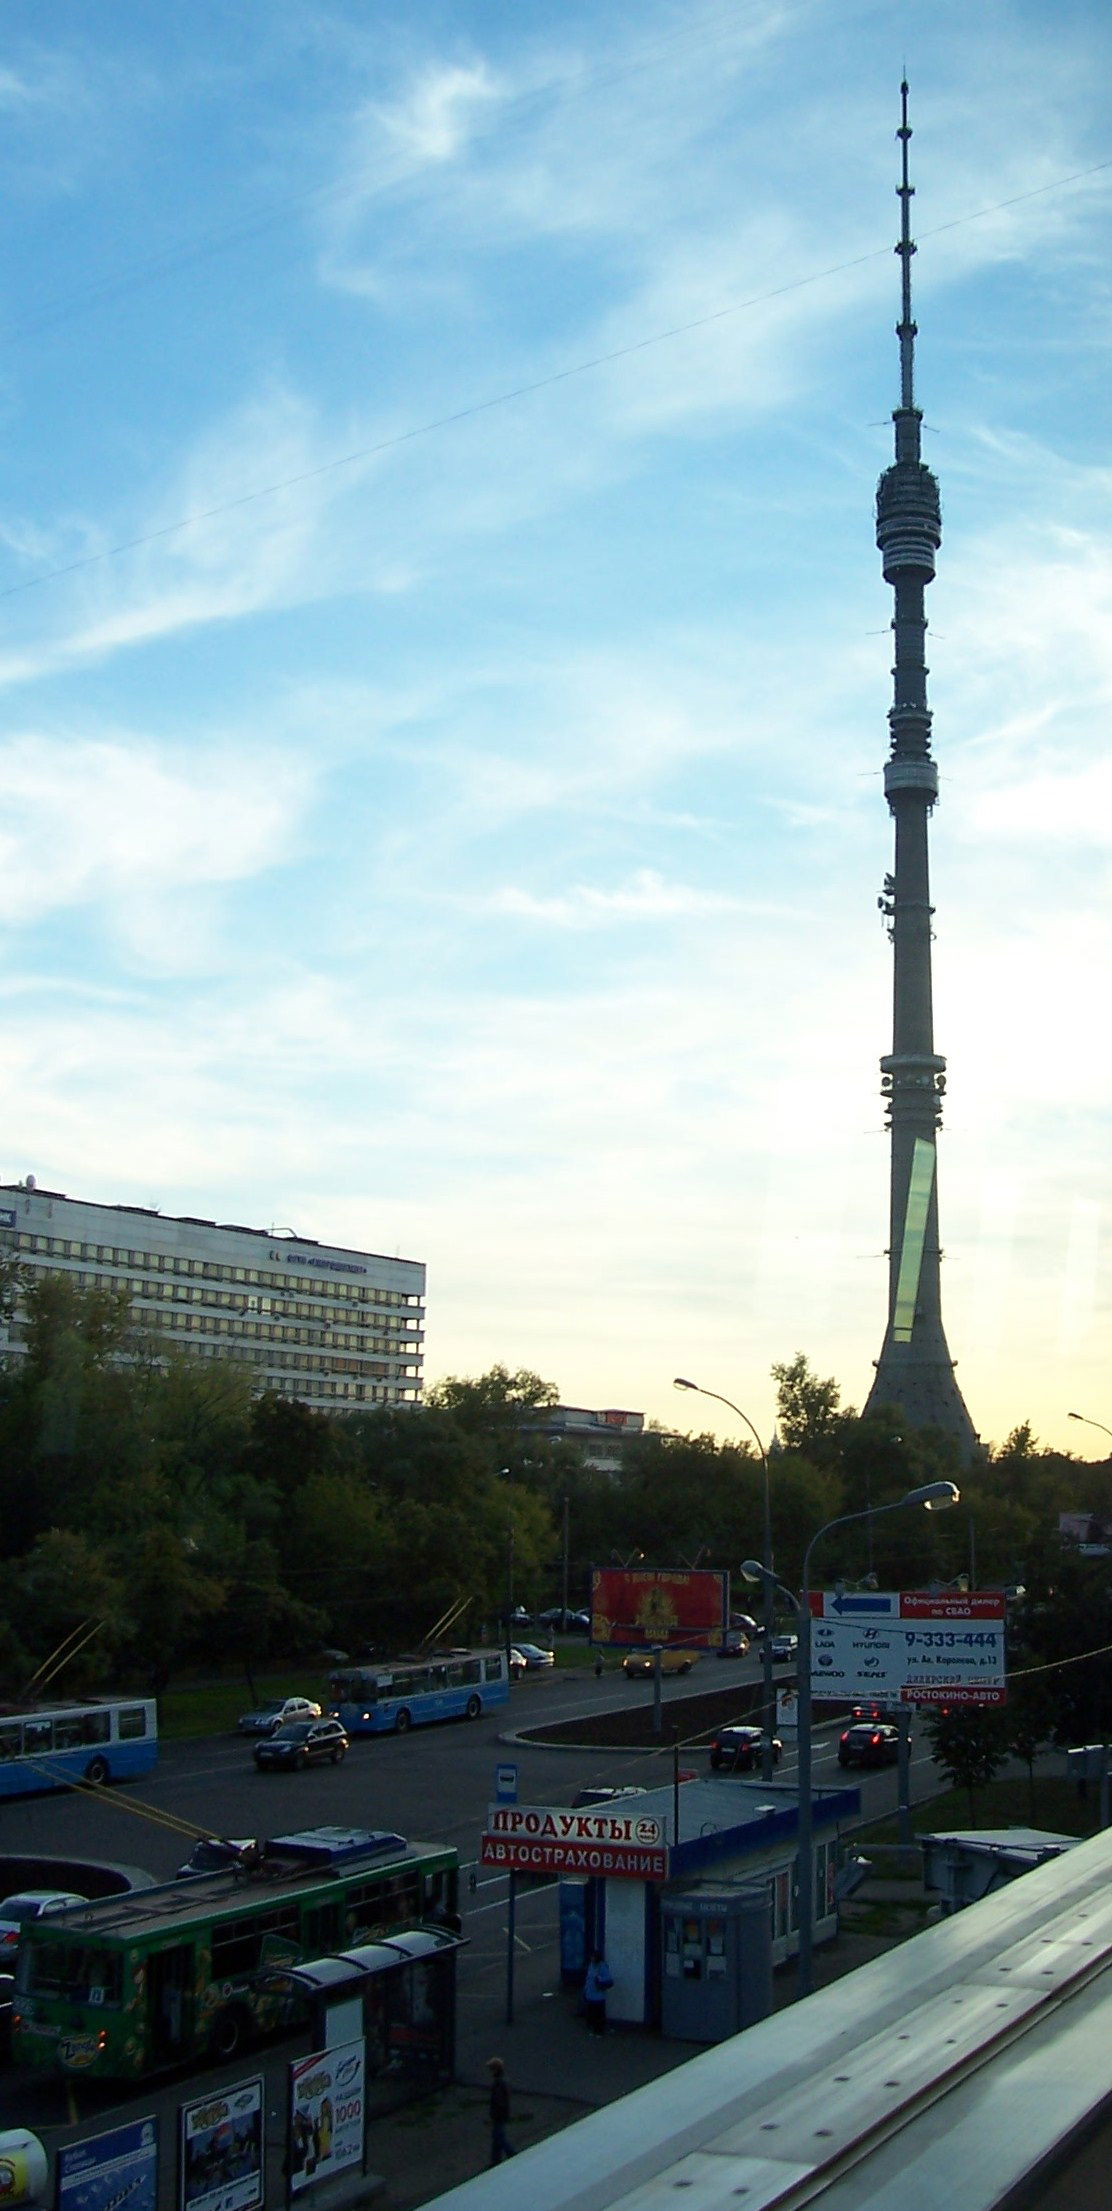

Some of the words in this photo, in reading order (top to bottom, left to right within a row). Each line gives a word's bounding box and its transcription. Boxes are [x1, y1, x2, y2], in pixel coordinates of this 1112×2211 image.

[814, 1641, 836, 1649] LADA
[905, 1632, 997, 1648] 9-333-444
[907, 1689, 1000, 1701] РОСТОКИНО-АВТО
[493, 1810, 632, 1840] ПРОДУКТЫ
[638, 1822, 656, 1835] 24
[483, 1842, 664, 1874] АВТОСТРАХОВАНИЕ
[335, 2099, 362, 2123] 1000
